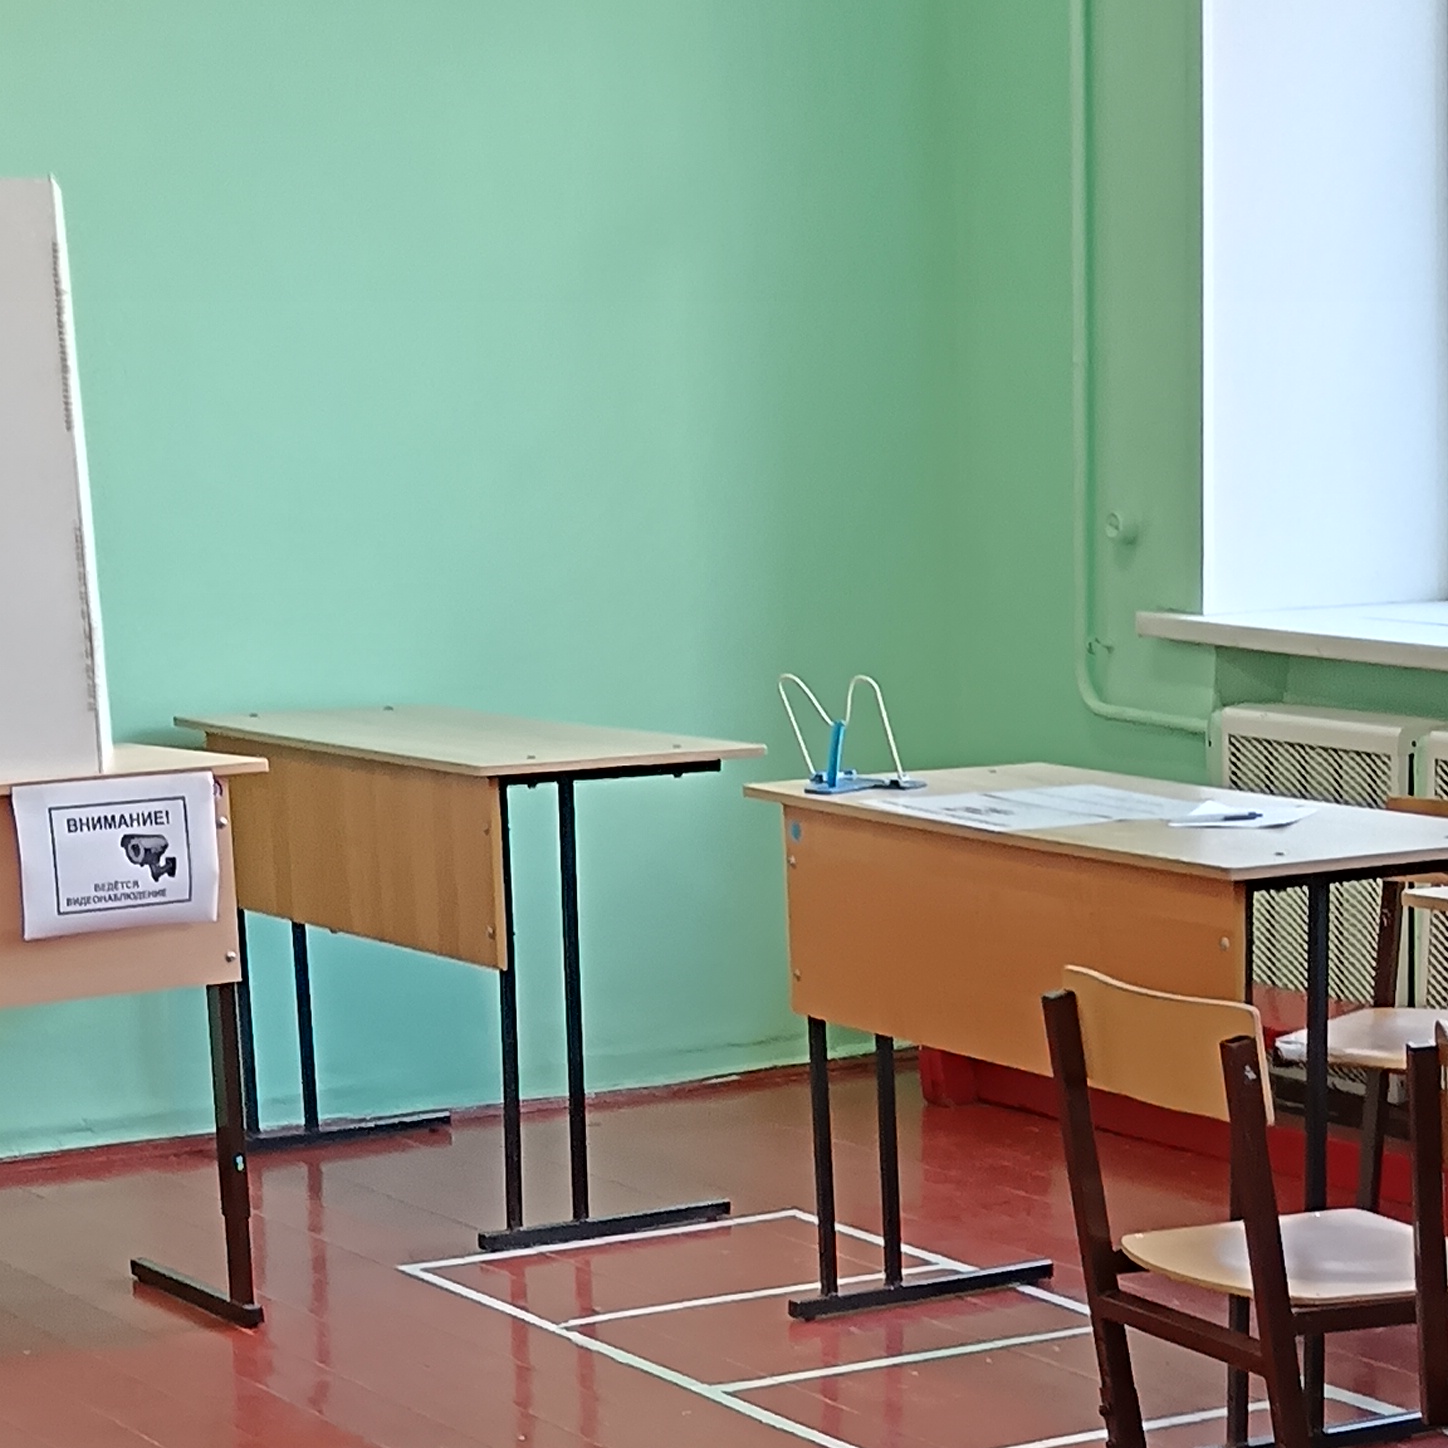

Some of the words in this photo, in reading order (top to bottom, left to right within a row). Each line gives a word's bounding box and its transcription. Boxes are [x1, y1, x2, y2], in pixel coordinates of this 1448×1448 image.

[66, 810, 170, 833] ВНИМАНИЕ!
[93, 880, 140, 893] ВЕДЁТСЯ
[66, 888, 167, 907] ВИДЕОНАБЛЮДЕНИЕ
